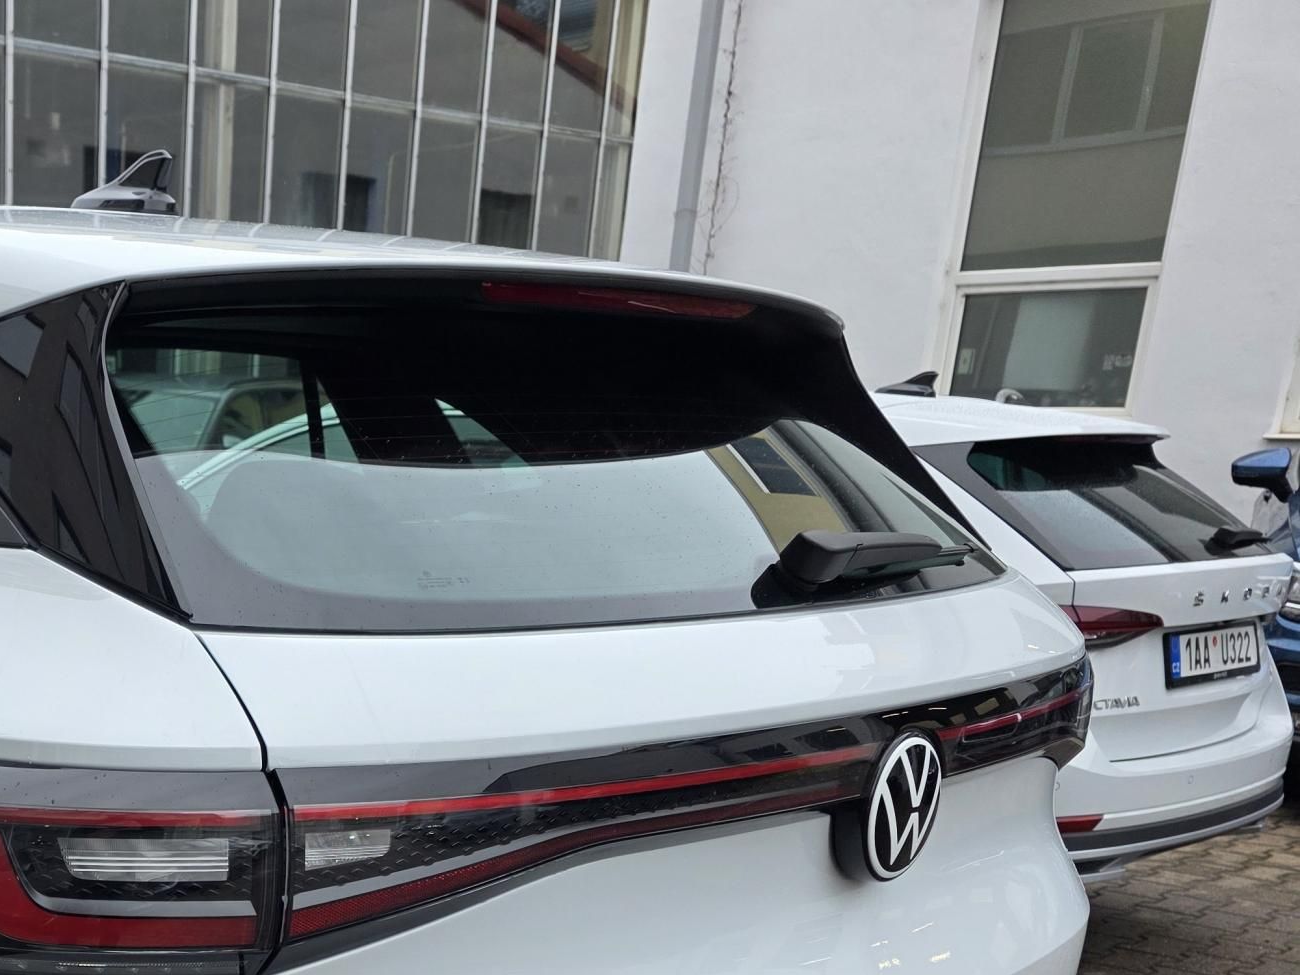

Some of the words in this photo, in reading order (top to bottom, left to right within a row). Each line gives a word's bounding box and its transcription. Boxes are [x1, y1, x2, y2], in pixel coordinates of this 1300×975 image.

[1185, 636, 1211, 671] 1AA
[1221, 631, 1252, 665] U322
[1093, 696, 1141, 710] CTAVIA
